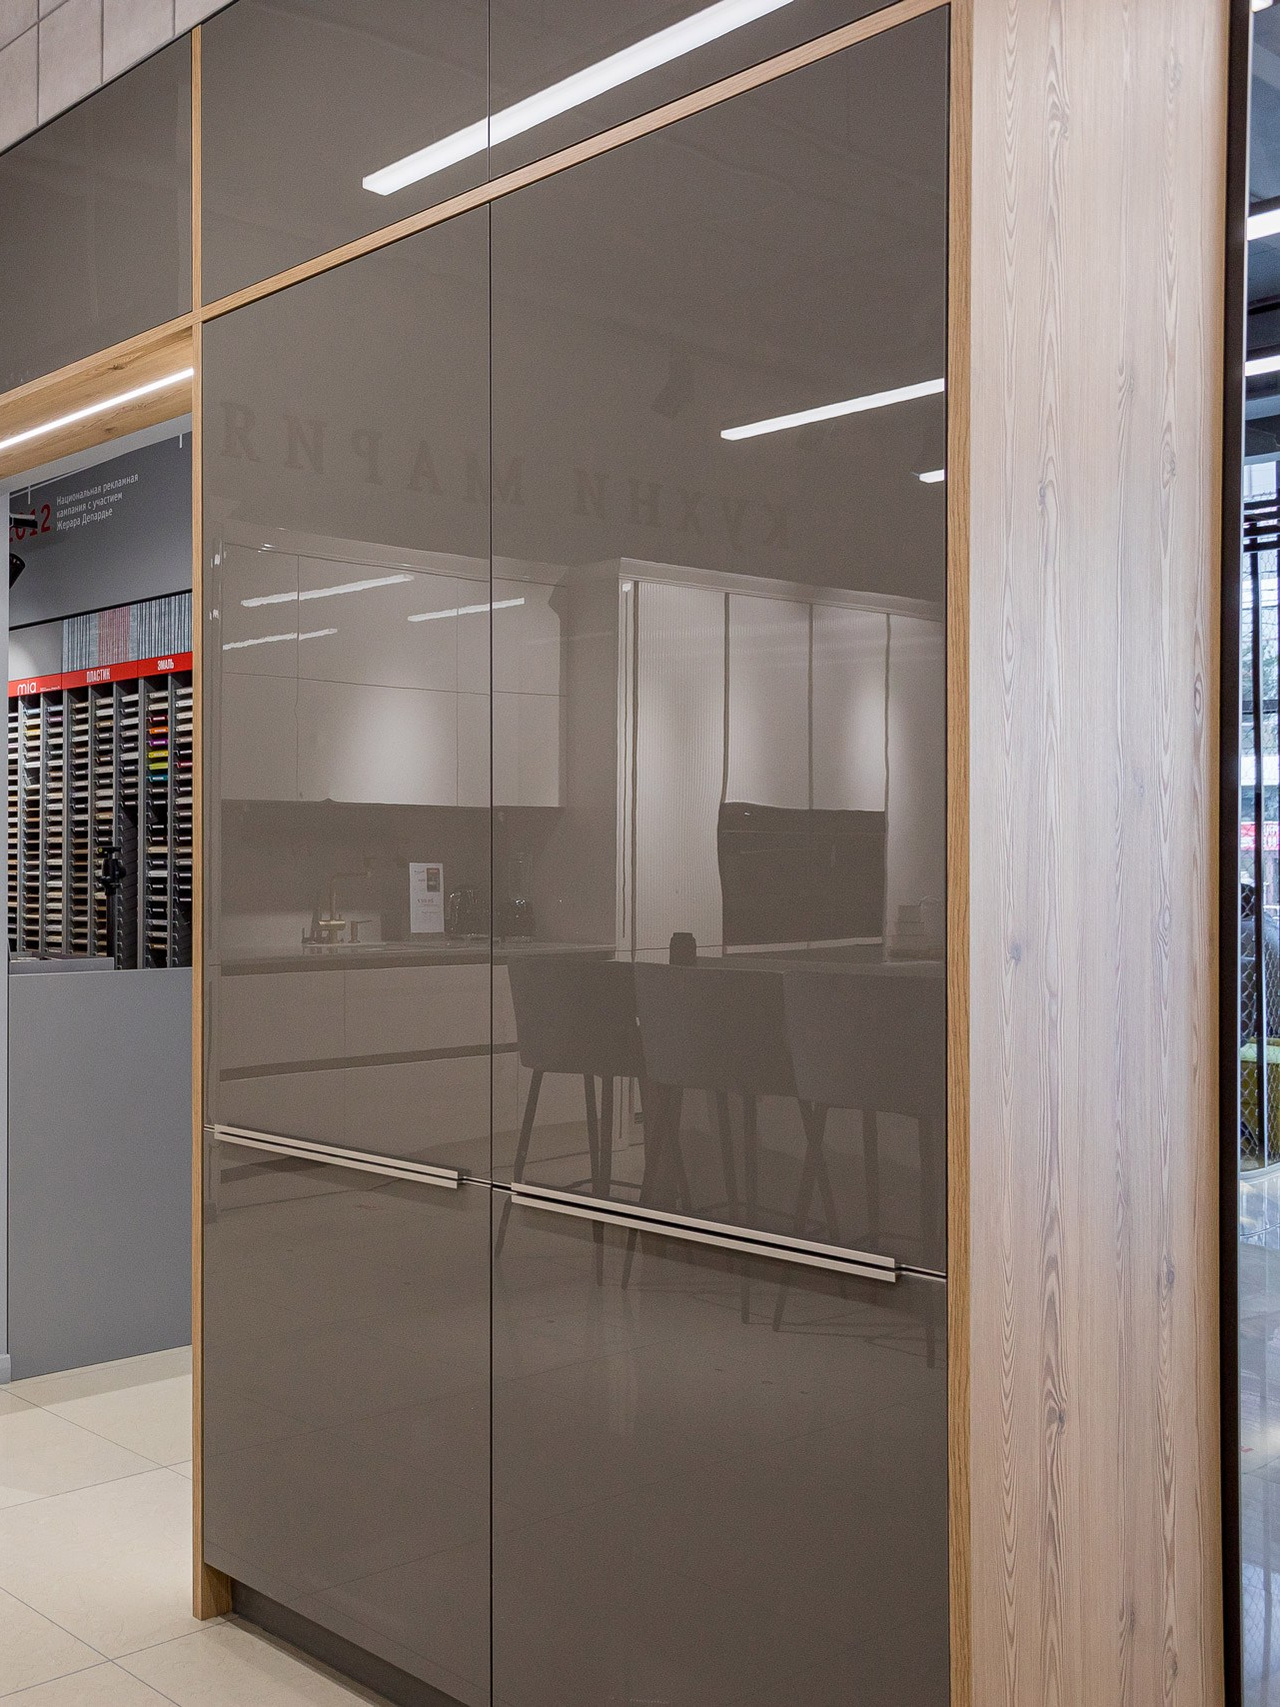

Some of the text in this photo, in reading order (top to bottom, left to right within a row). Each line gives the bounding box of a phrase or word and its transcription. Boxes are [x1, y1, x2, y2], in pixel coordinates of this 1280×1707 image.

[56, 473, 139, 506] Национальная рекламная
[56, 492, 123, 519] кампания с участием
[56, 507, 113, 532] Жерара Депардье
[157, 658, 175, 671] ЭМАЛЬ
[86, 668, 111, 683] ПЛАСТИК
[17, 680, 37, 696] mia
